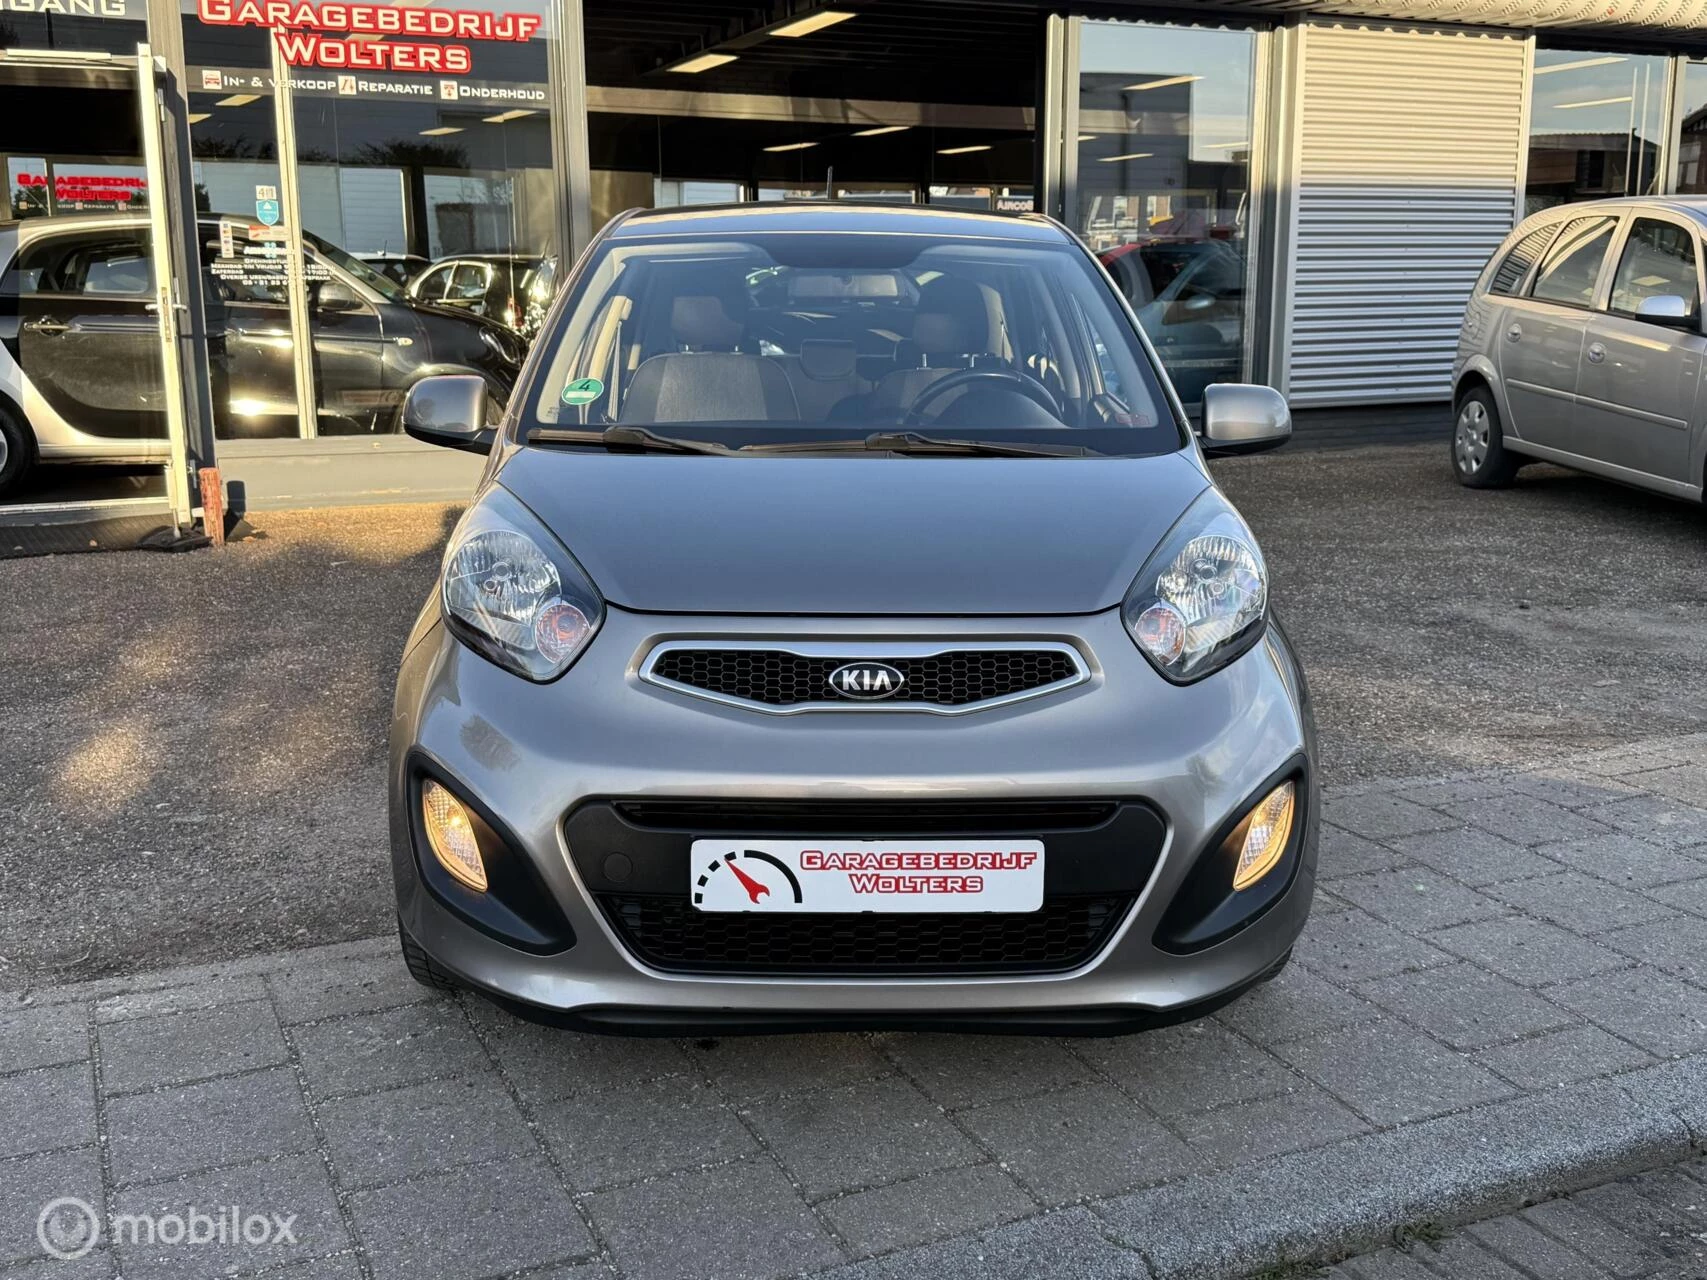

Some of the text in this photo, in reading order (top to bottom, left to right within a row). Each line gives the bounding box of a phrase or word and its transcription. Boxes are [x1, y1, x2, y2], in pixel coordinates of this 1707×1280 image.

[0, 0, 126, 16] GANG
[199, 0, 542, 41] GARAGEBEDRIJF
[275, 32, 472, 73] WOLTERS
[251, 77, 264, 88] &
[358, 80, 433, 95] REPARATIE
[459, 85, 545, 100] ONDERHOUD
[578, 379, 591, 392] 4
[841, 669, 893, 691] KIA
[800, 850, 1037, 870] GARAGEBEDRIJF
[849, 873, 983, 893] WOLTERS
